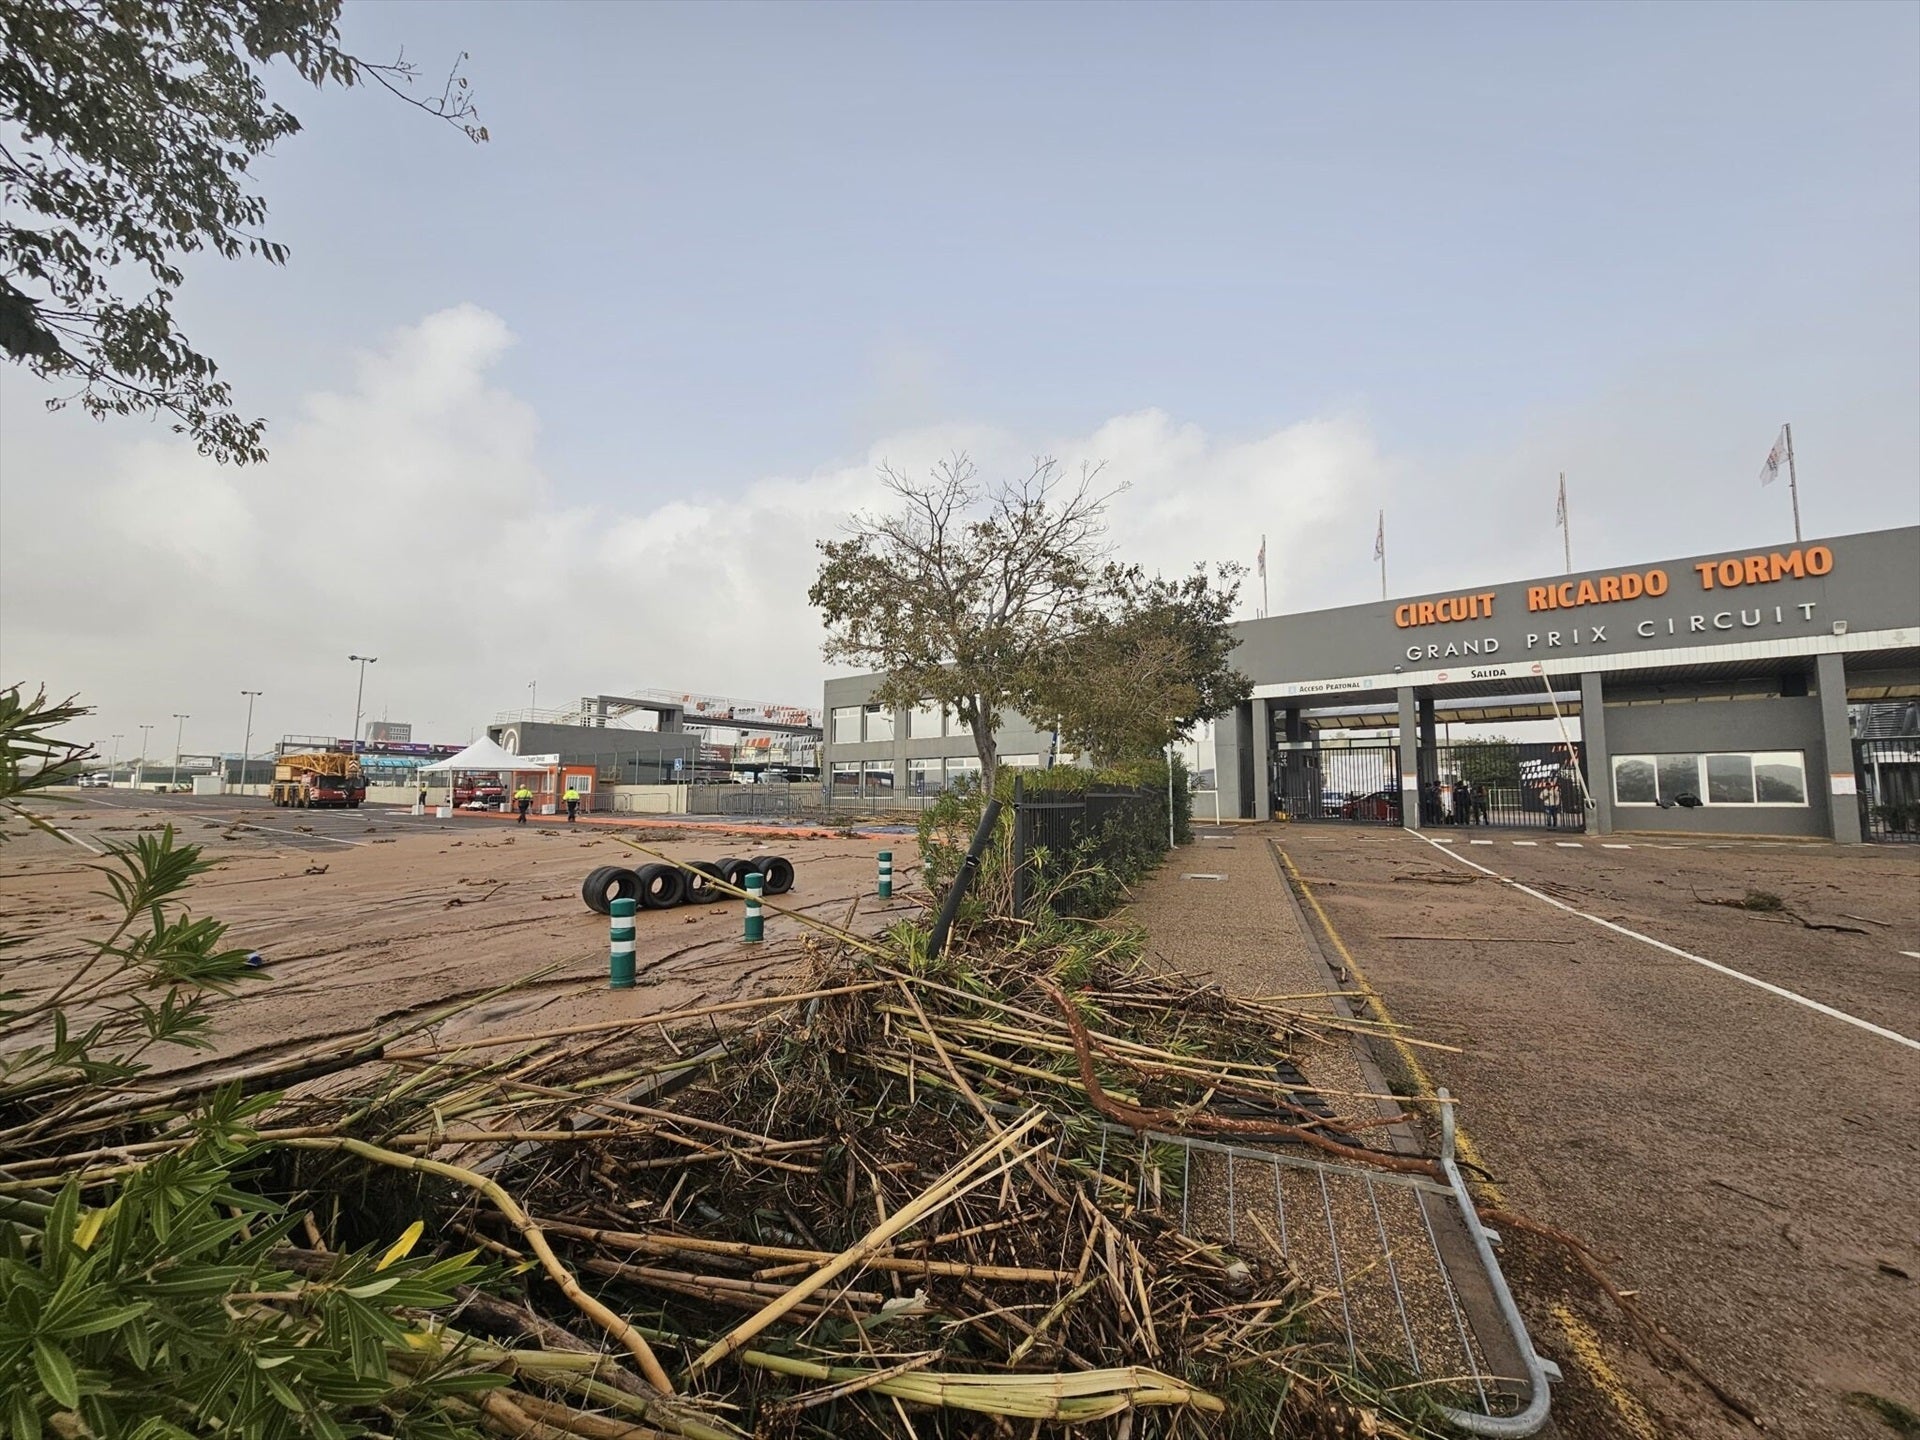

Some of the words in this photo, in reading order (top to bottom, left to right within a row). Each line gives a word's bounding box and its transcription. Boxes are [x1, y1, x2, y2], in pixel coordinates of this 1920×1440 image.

[1394, 592, 1496, 628] CIRCUIT
[1527, 569, 1669, 612] RICARDO
[1695, 545, 1834, 590] TORMO
[1406, 637, 1500, 662] GRAND
[1526, 625, 1608, 650] PRIX
[1637, 602, 1817, 638] CIRCUIT
[1299, 685, 1324, 693] ACCESO
[1325, 682, 1361, 691] PEATONAL
[1471, 668, 1507, 679] SALIDA
